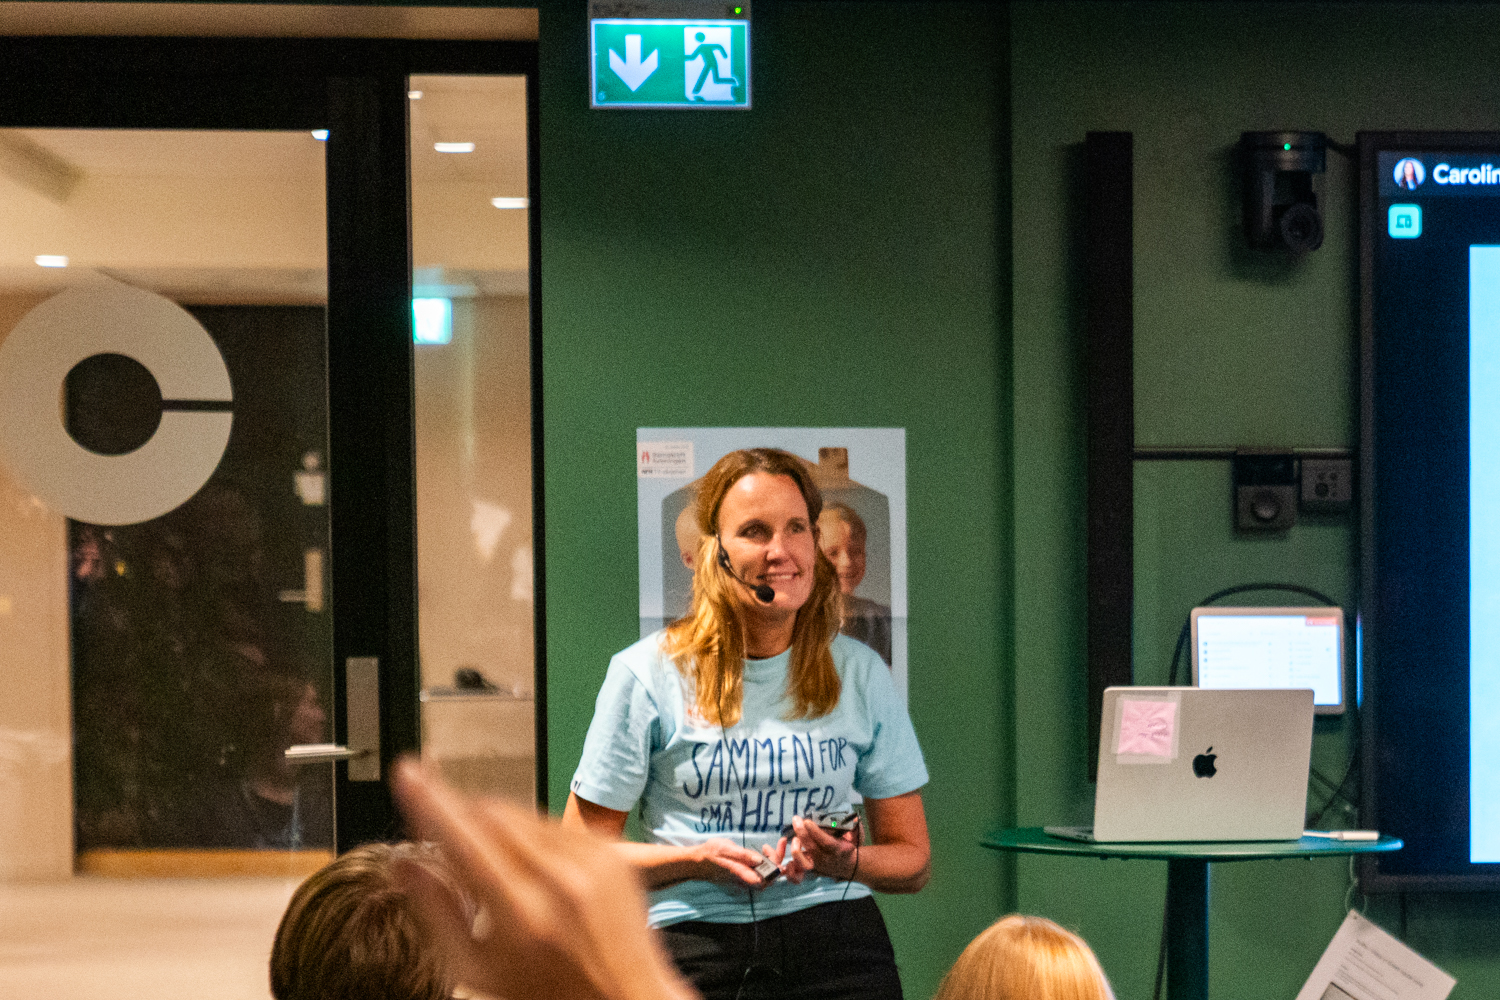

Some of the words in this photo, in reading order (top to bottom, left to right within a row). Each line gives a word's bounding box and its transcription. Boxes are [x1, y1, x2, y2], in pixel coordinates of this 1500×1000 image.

[683, 732, 815, 798] SAMMEN
[819, 737, 848, 774] FOR
[695, 801, 734, 833] SMÅ
